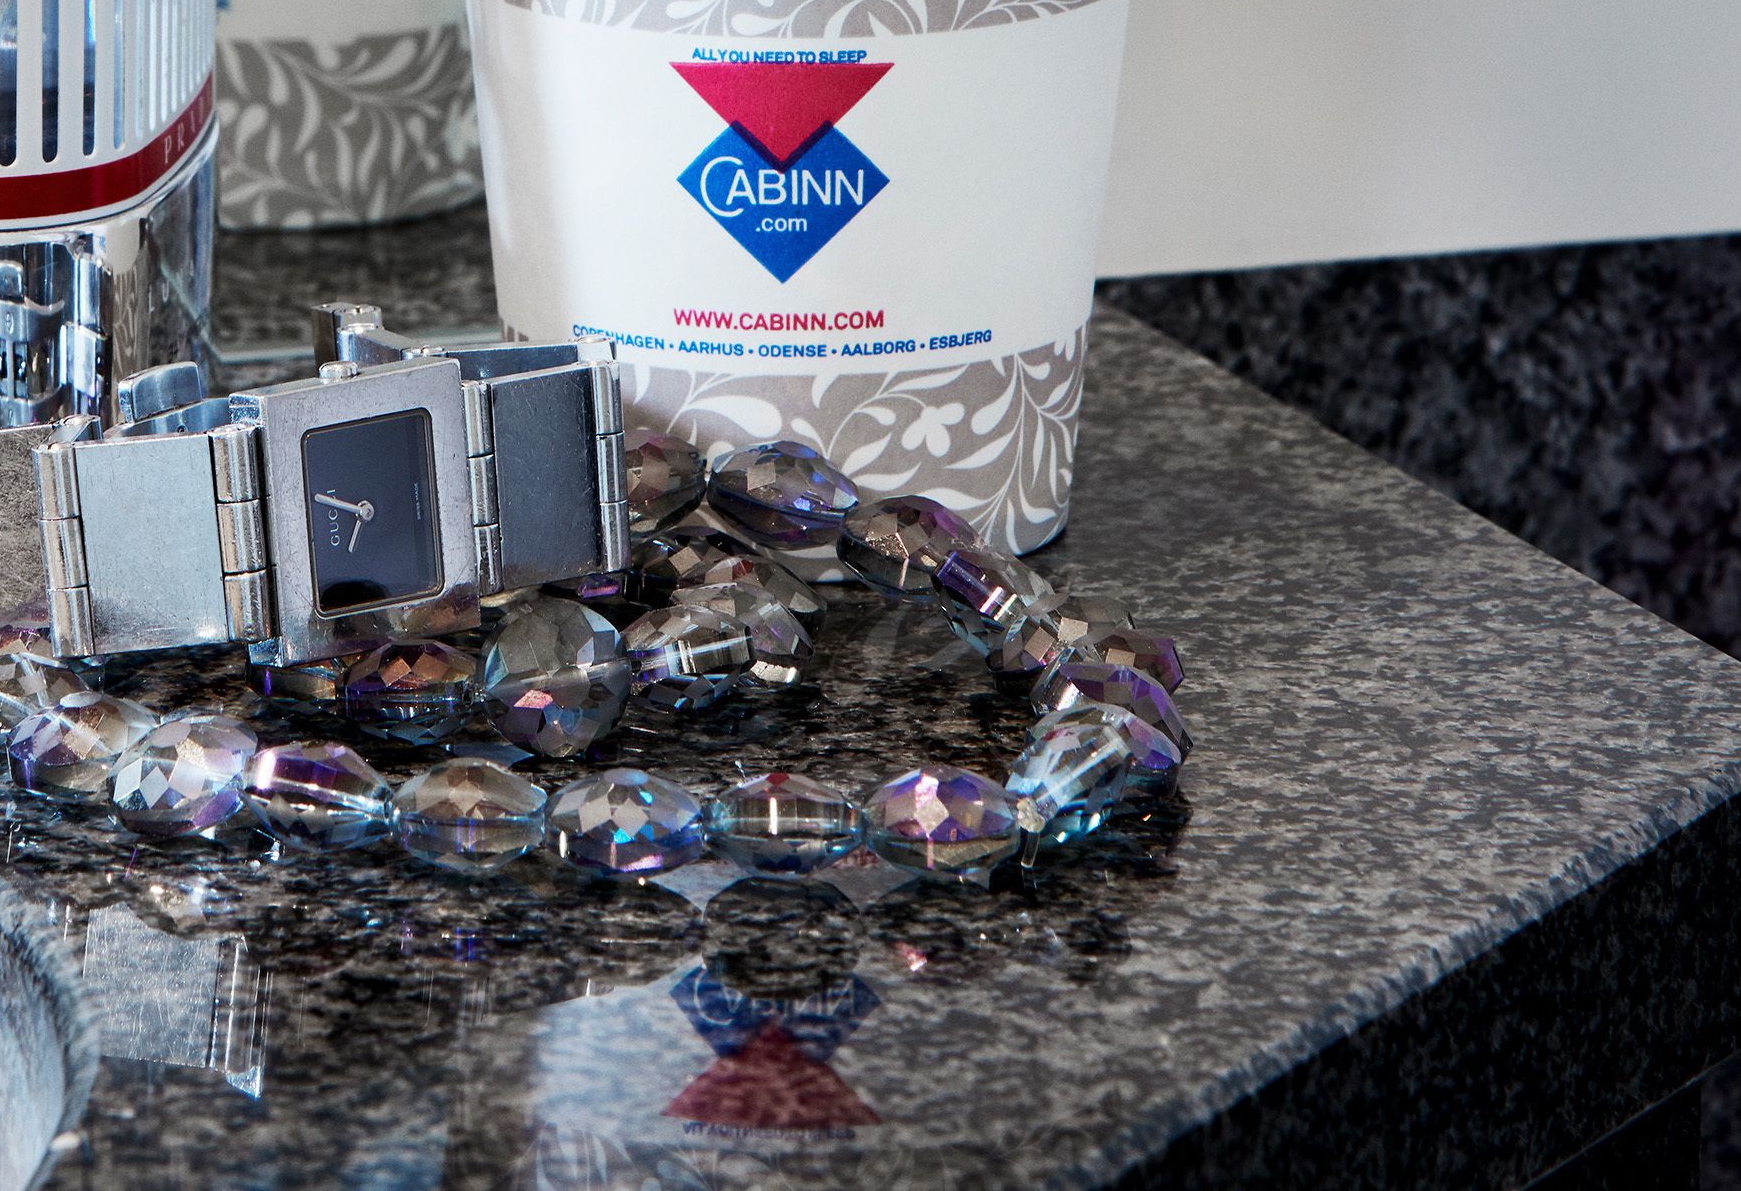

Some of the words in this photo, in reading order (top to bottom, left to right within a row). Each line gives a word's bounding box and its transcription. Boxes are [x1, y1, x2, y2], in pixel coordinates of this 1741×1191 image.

[692, 47, 718, 61] ALL
[718, 49, 750, 65] YOU
[753, 50, 795, 65] NEED
[796, 50, 816, 65] TO
[818, 49, 868, 65] SLEEP
[700, 155, 864, 218] CABINN
[755, 215, 808, 234] .com
[673, 307, 885, 333] WWW.CABINN.COM
[678, 340, 745, 357] AARHUS
[757, 344, 828, 358] ODENSE
[840, 339, 917, 357] AALBORG
[928, 328, 993, 351] ESBJERG
[326, 488, 341, 547] GUCI
